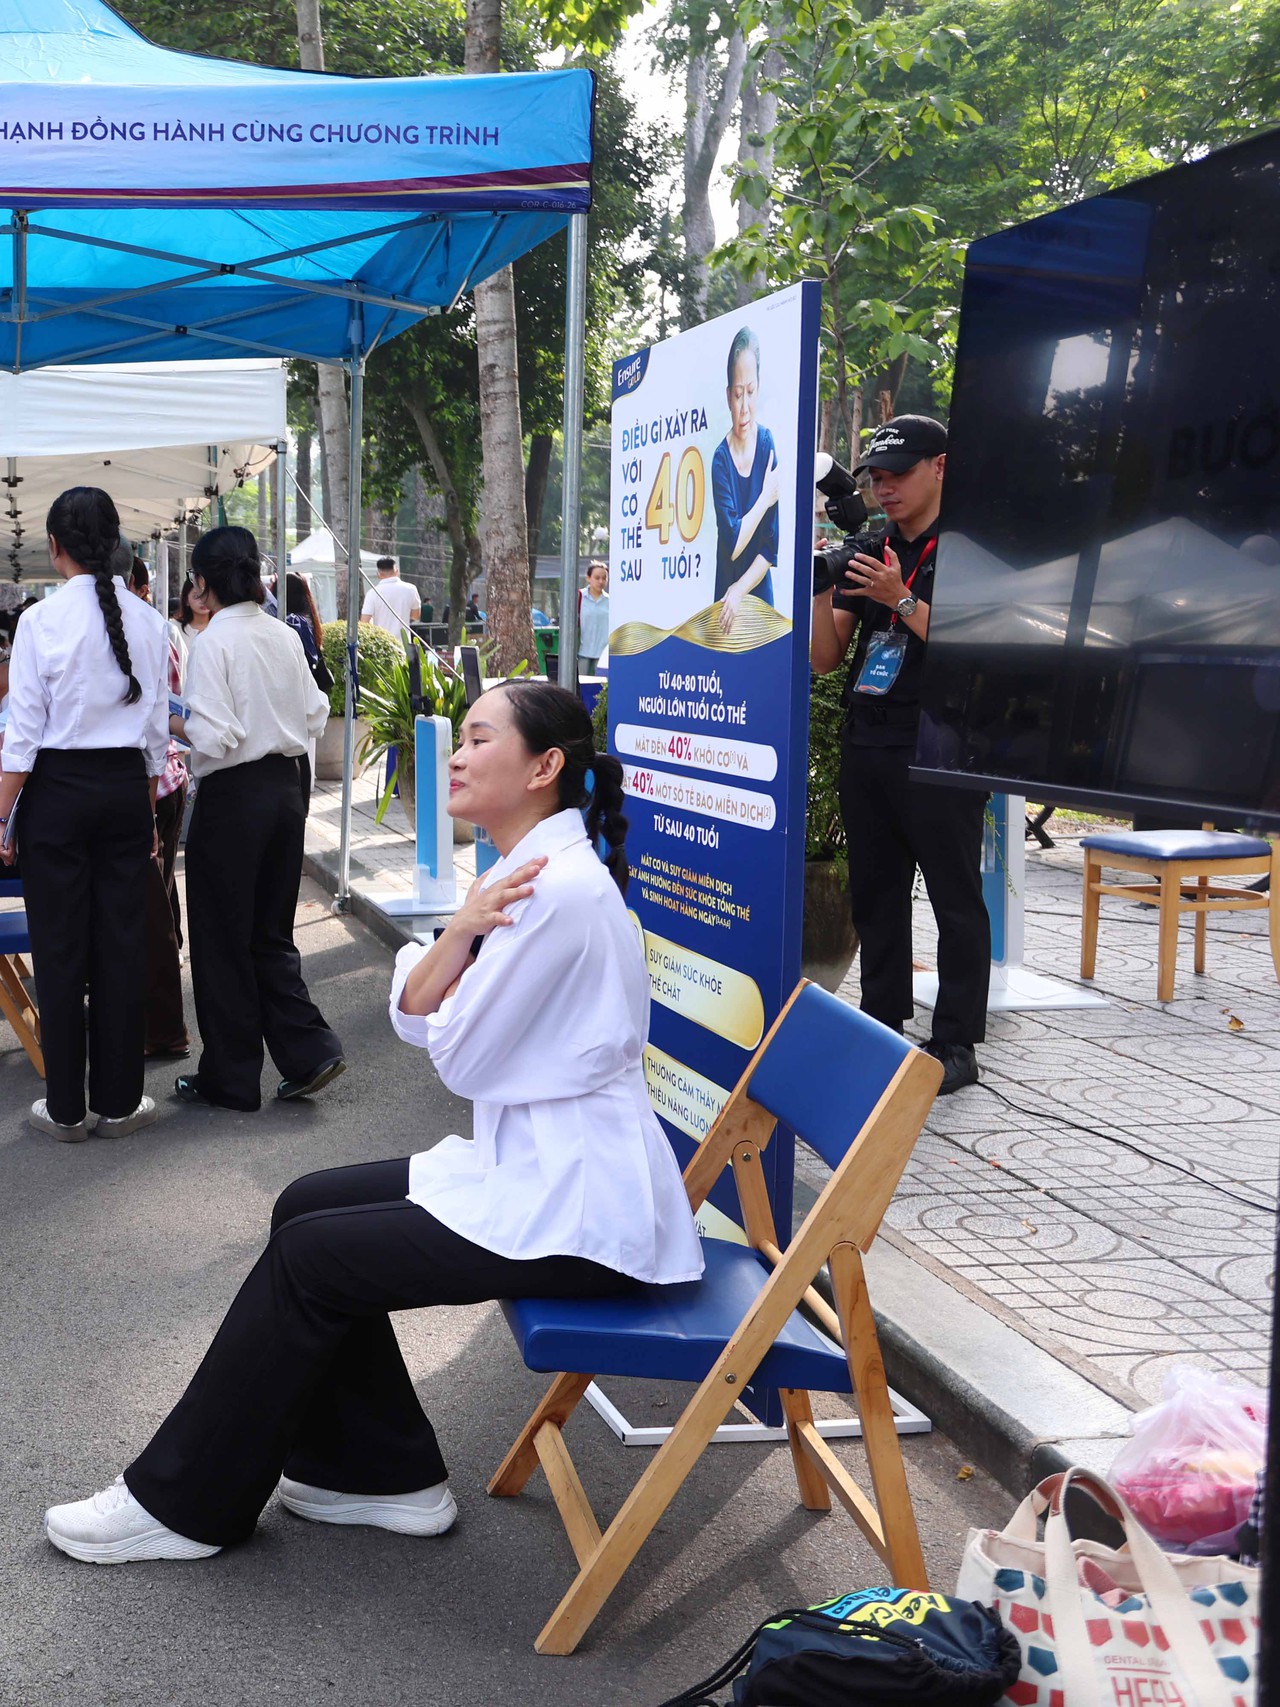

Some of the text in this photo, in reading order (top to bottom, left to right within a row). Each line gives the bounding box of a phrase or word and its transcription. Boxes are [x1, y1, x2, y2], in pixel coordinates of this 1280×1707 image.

[71, 115, 146, 141] ĐỒNG
[153, 119, 224, 141] HÀNH
[231, 120, 303, 142] CÙNG
[310, 122, 419, 145] CHƯƠNG
[426, 122, 500, 146] TRÌNH
[617, 356, 641, 387] Ensure
[622, 406, 708, 452] ĐIỀU GÌ XẢY RA
[622, 457, 642, 485] VỚI
[622, 492, 638, 517] CƠ
[645, 446, 705, 544] 40
[621, 517, 642, 549] THỂ
[620, 546, 701, 582] SAU TUỔI ?
[659, 670, 723, 698] TỪ 40-80 TUỔI,
[639, 695, 746, 725] NGƯỜI LỚN TUỔI CÓ THỂ
[668, 736, 692, 761] 40%
[633, 771, 654, 796] 40%
[653, 813, 719, 849] TỪ SAU 40 TUỔI
[649, 949, 662, 965] SUY
[690, 1111, 711, 1135] LƯỢN
